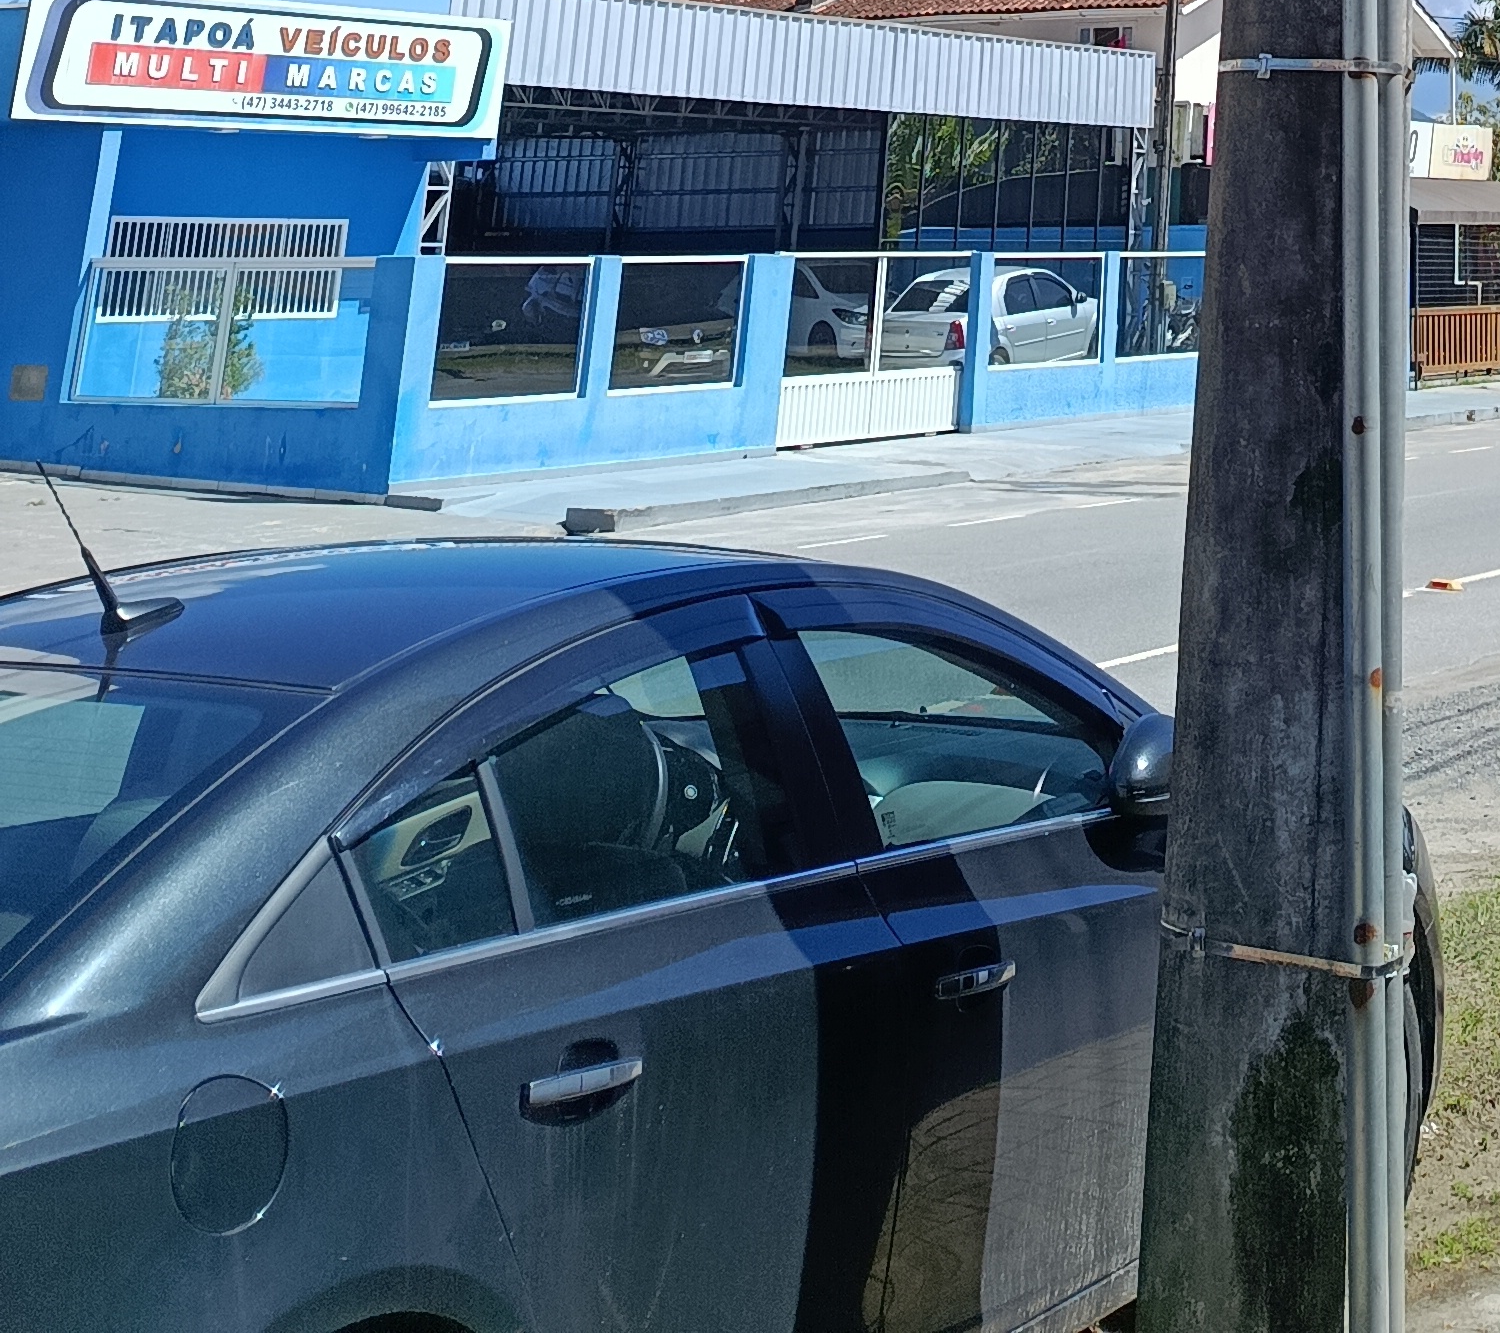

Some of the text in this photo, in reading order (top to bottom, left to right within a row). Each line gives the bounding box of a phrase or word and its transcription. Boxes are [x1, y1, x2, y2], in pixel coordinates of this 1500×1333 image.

[110, 14, 451, 64] ITAPOÁ VEÍCULOS
[113, 51, 438, 95] MULTI MARCAS
[241, 95, 267, 112] (47)
[269, 96, 334, 112] 3443-2718
[355, 101, 379, 117] (47)
